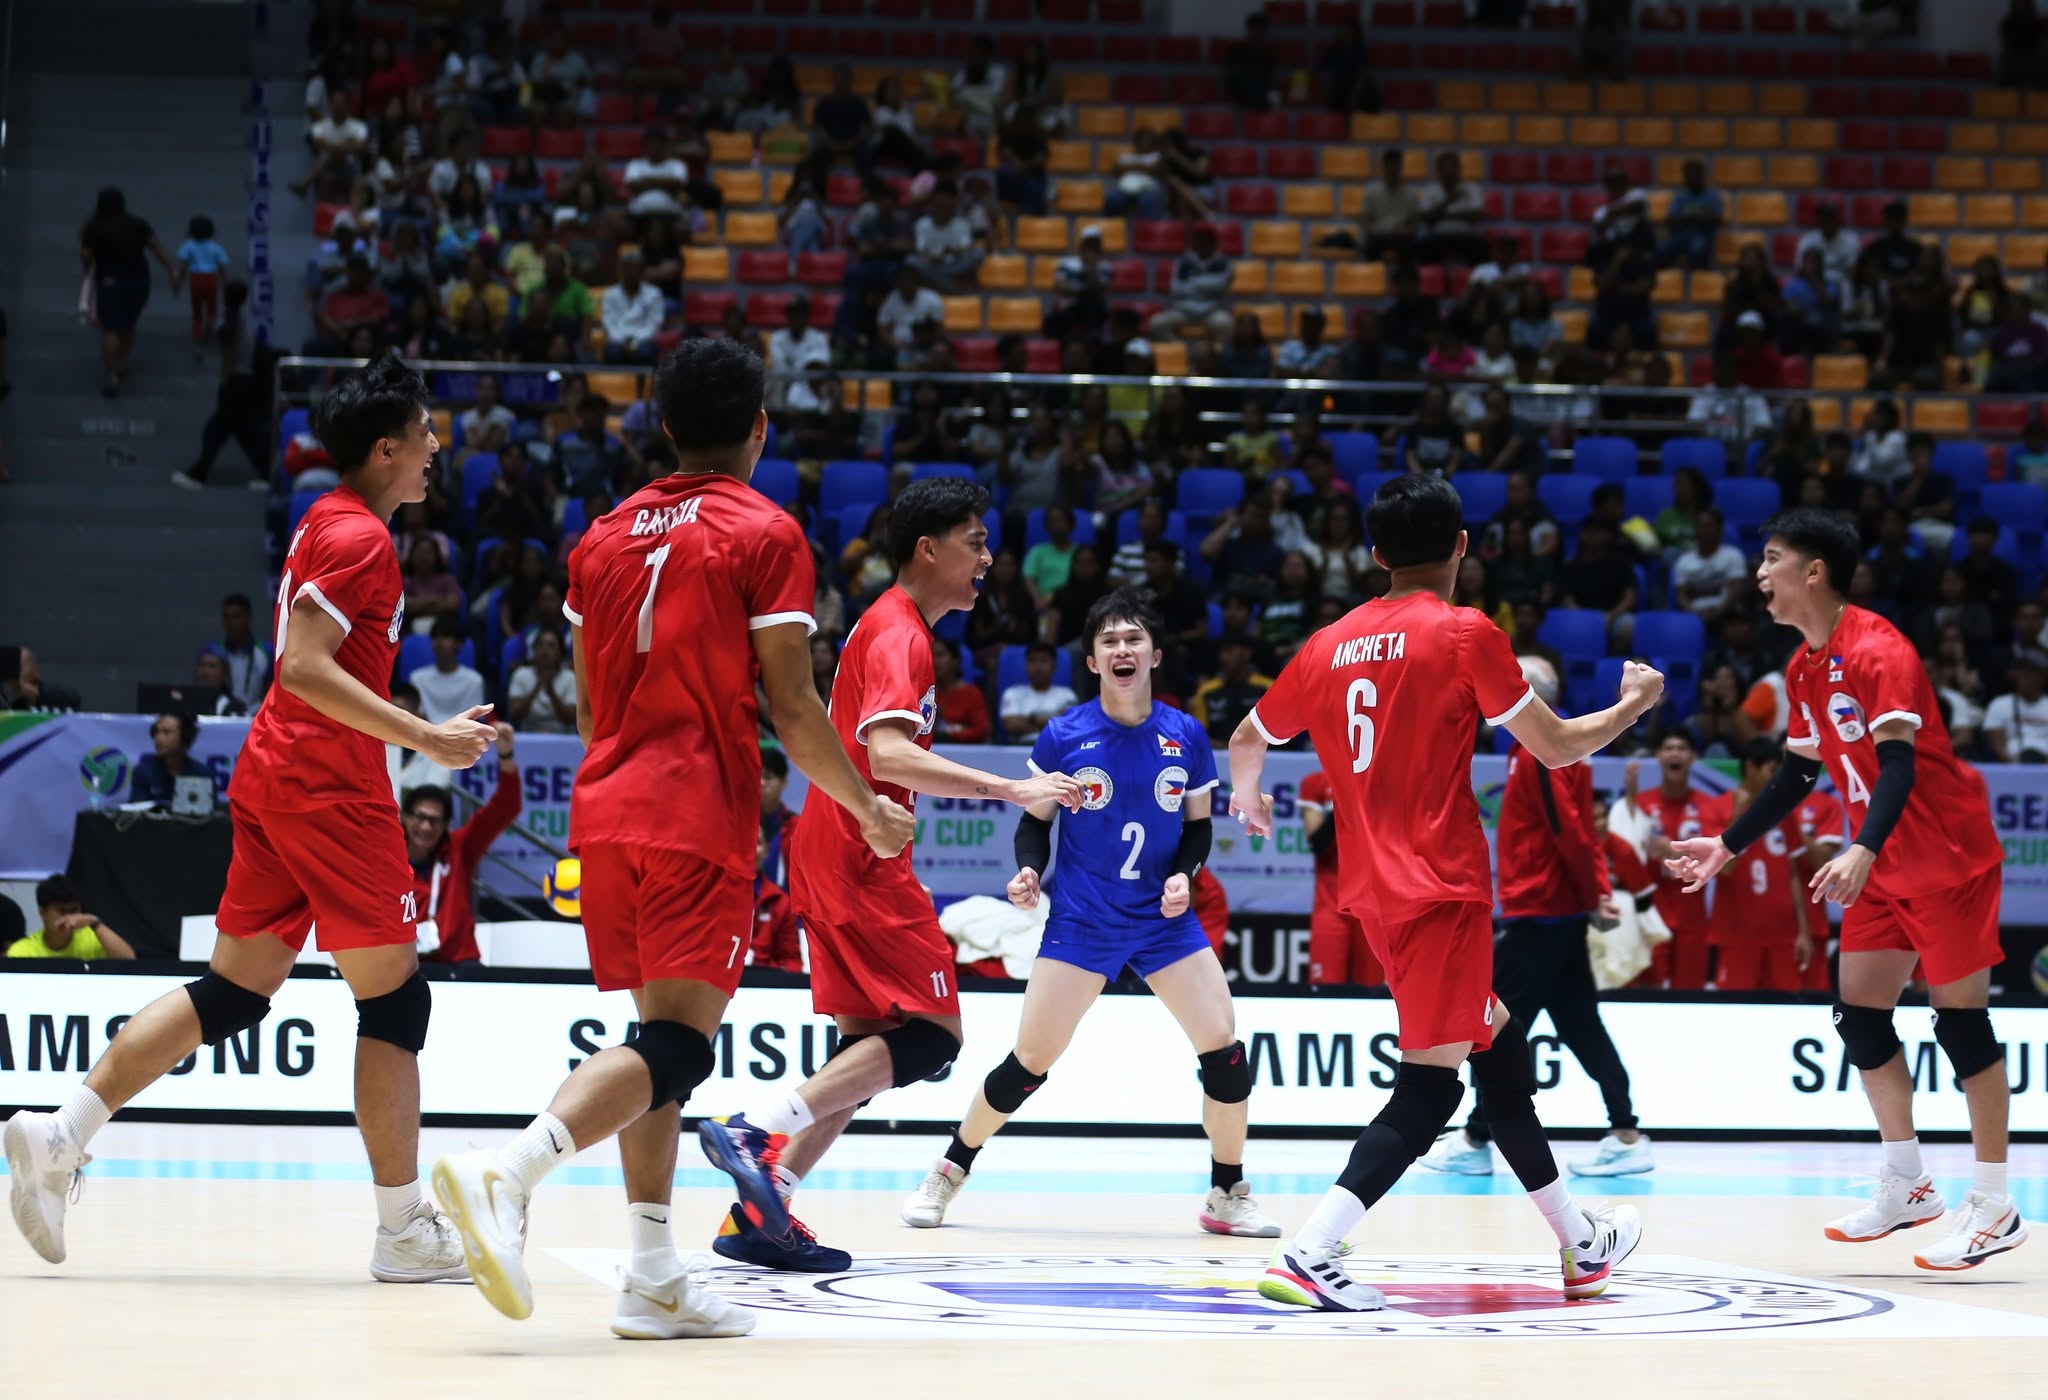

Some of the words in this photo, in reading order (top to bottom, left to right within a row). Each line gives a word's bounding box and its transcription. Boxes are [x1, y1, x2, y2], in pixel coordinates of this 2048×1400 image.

[636, 543, 672, 654] 7
[1331, 632, 1406, 670] ANCHETA
[1346, 678, 1378, 774] 6
[524, 765, 573, 802] SE
[1840, 753, 1872, 809] 4
[529, 810, 568, 837] CU
[1996, 794, 2048, 830] SE
[935, 818, 995, 847] CUP
[1276, 827, 1314, 854] CU
[1120, 821, 1146, 880] 2
[2002, 837, 2048, 864] CU
[1752, 860, 1768, 895] 9
[400, 891, 417, 924] 20
[727, 935, 741, 969] 7
[930, 970, 948, 998] 11
[1483, 995, 1493, 1026] 6
[882, 1258, 1270, 1268] SPORT
[1383, 1263, 1838, 1310] COMISSION
